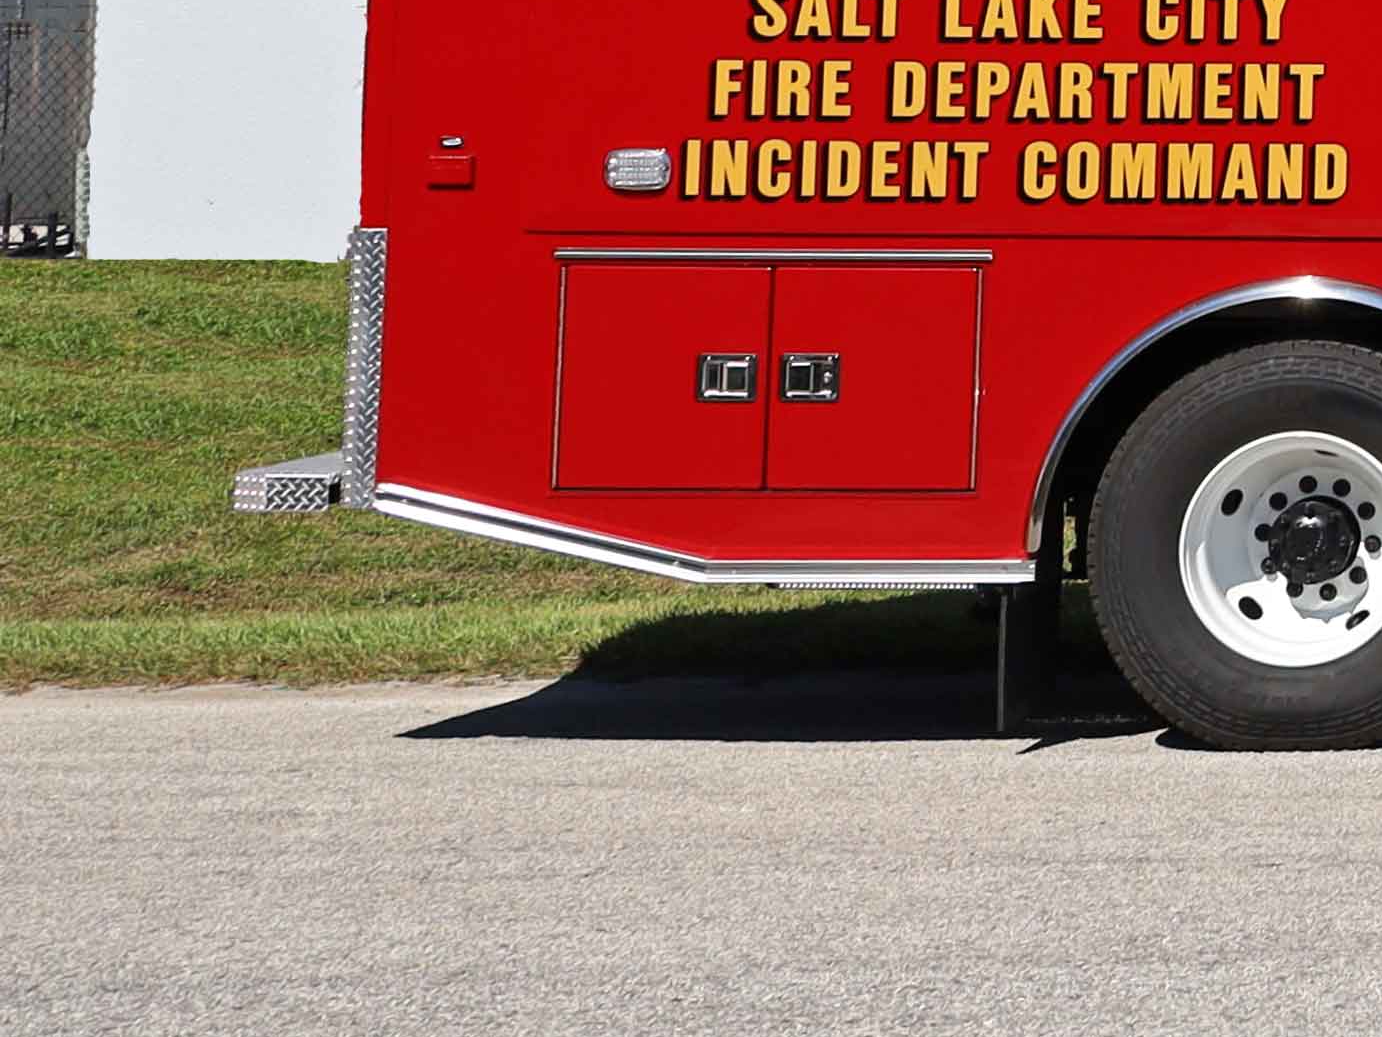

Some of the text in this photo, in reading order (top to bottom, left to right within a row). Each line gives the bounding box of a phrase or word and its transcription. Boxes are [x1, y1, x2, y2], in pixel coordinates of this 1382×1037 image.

[712, 59, 1325, 121] FIRE DEPARTMENT
[683, 138, 1348, 201] INCIDENT COMMAND
